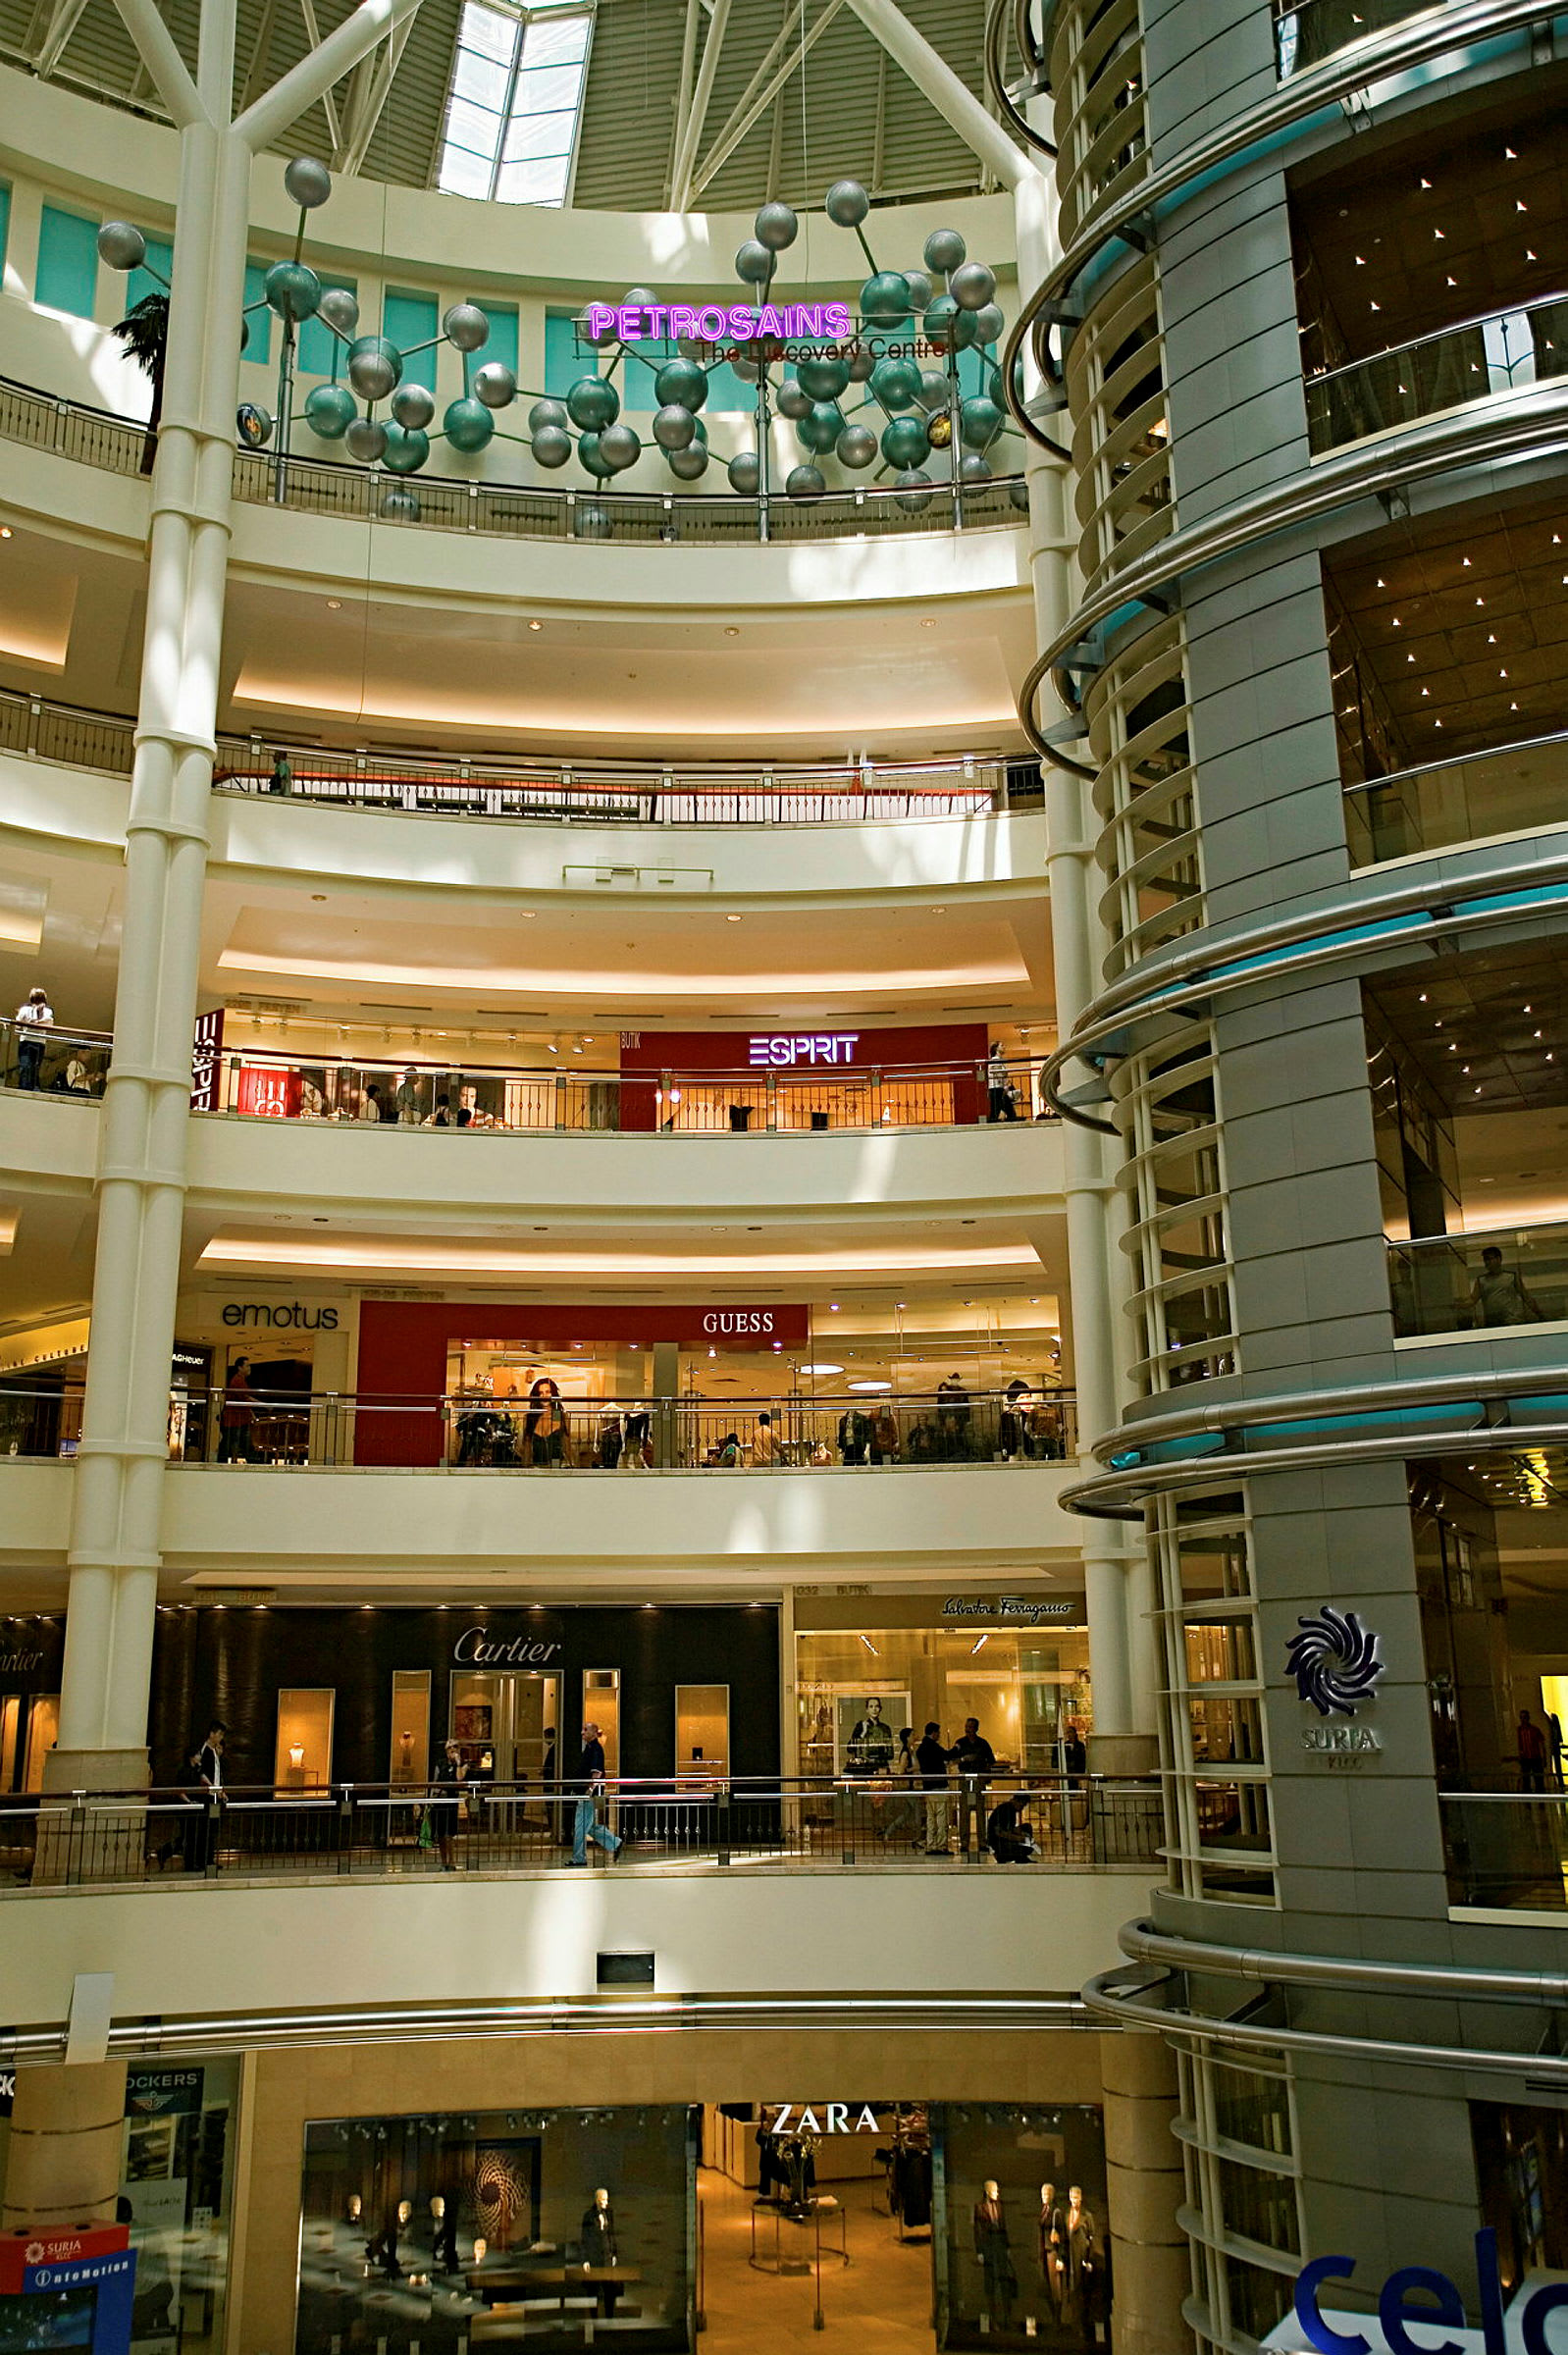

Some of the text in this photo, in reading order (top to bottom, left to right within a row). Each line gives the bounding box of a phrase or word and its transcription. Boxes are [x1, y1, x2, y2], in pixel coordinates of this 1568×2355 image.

[590, 302, 851, 340] PETROSAINS
[698, 338, 946, 364] The Discovery Centre
[750, 1035, 860, 1065] ESPRIT
[223, 1301, 339, 1330] emotus
[703, 1313, 773, 1333] GUESS
[942, 1596, 1075, 1622] Salvatore Ferragamo
[0, 1640, 44, 1671] artier
[453, 1627, 561, 1662] Cartier
[1301, 1727, 1382, 1751] SURIA
[770, 2103, 880, 2134] ZARA
[47, 2239, 81, 2254] SURIA
